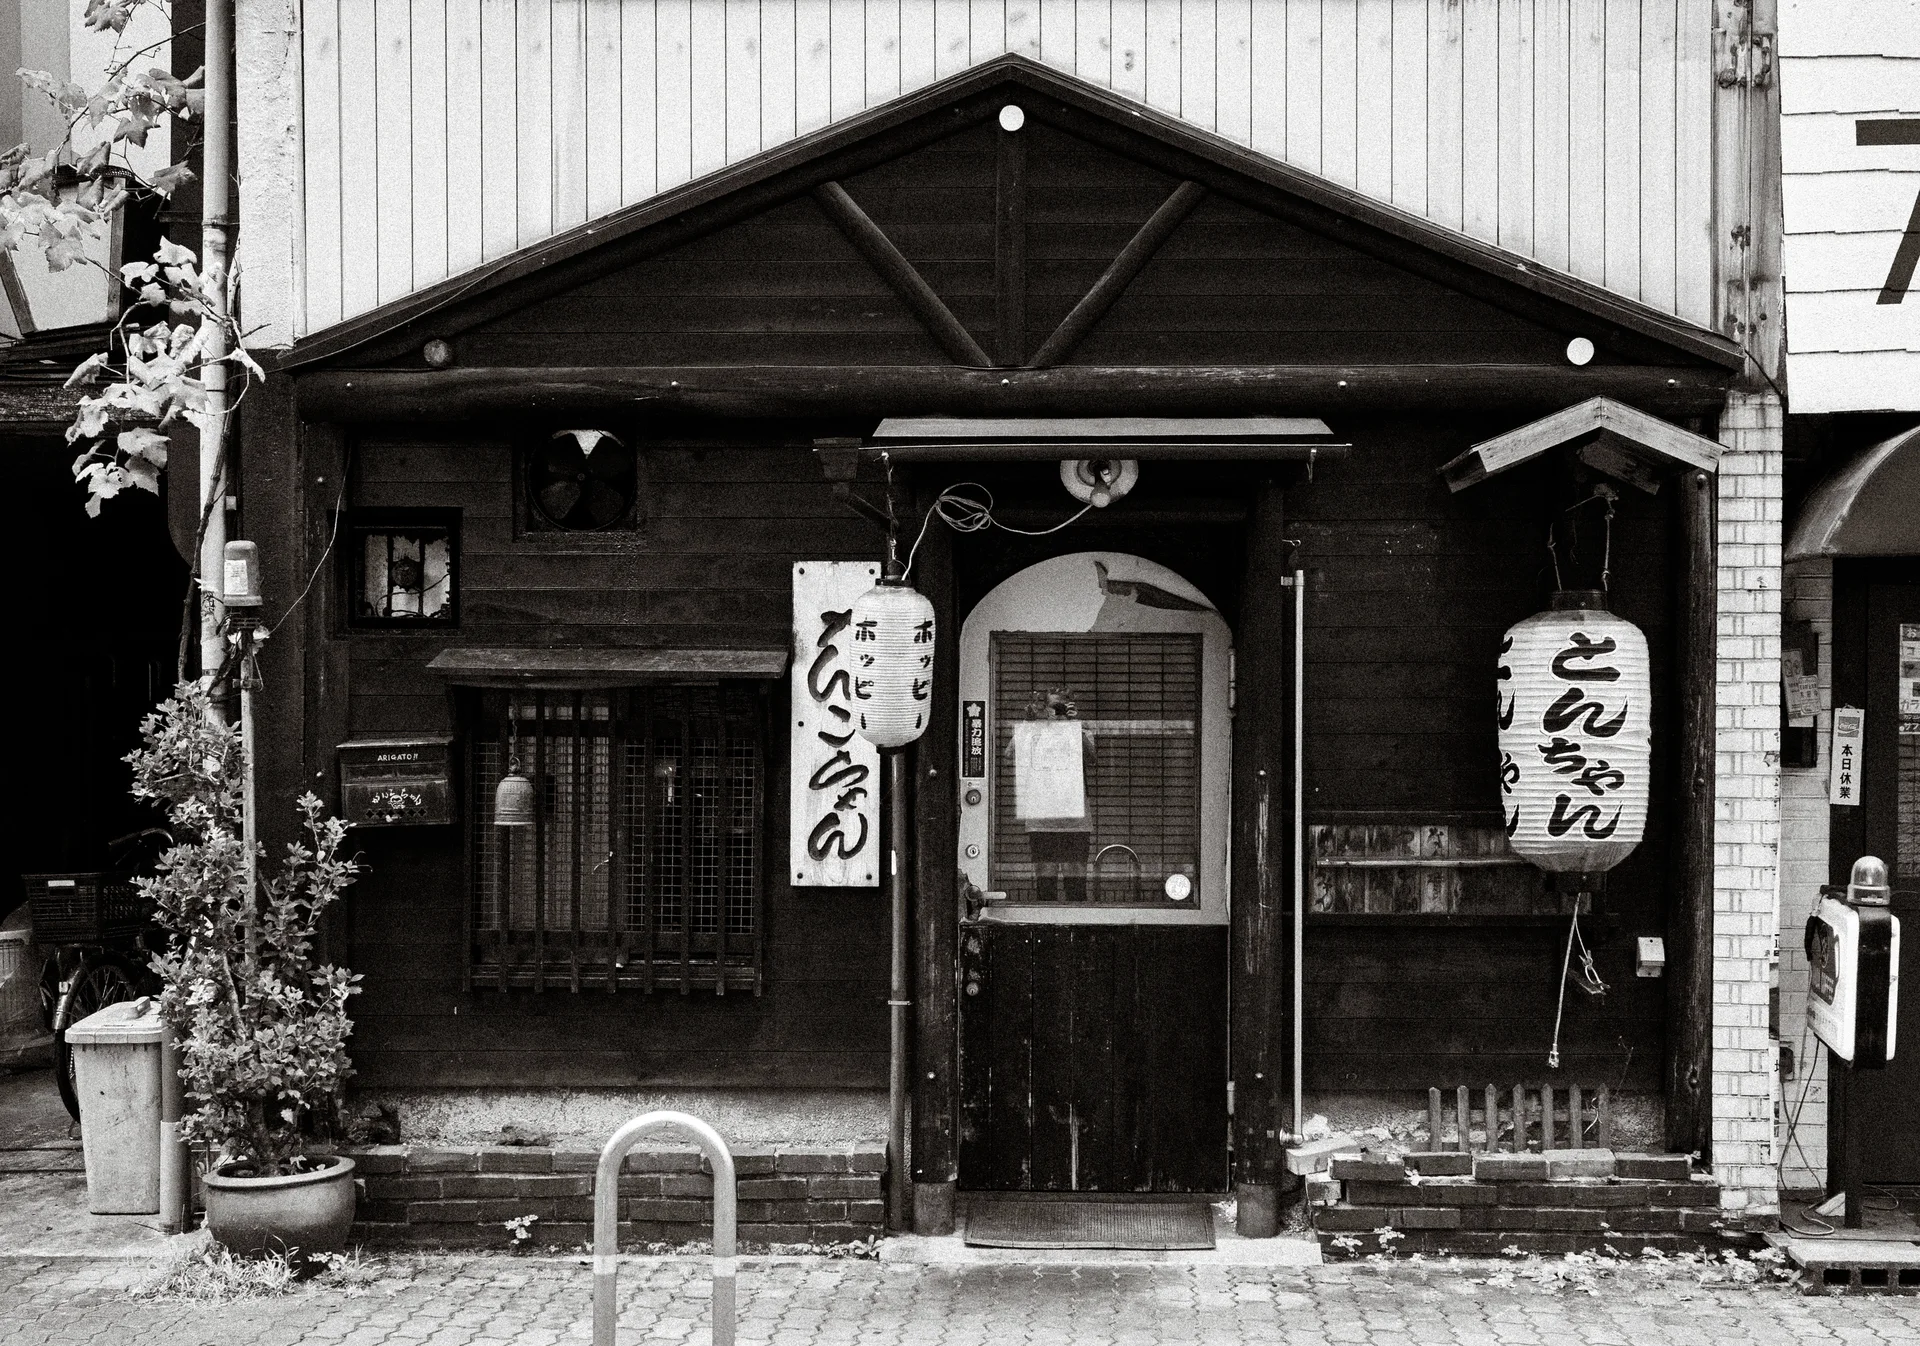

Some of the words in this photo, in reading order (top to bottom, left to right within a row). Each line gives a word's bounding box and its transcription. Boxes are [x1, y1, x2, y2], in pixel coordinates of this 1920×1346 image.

[855, 617, 878, 730] ホッピー
[1538, 632, 1629, 840] とんちゃん
[1839, 743, 1853, 799] 本日休業
